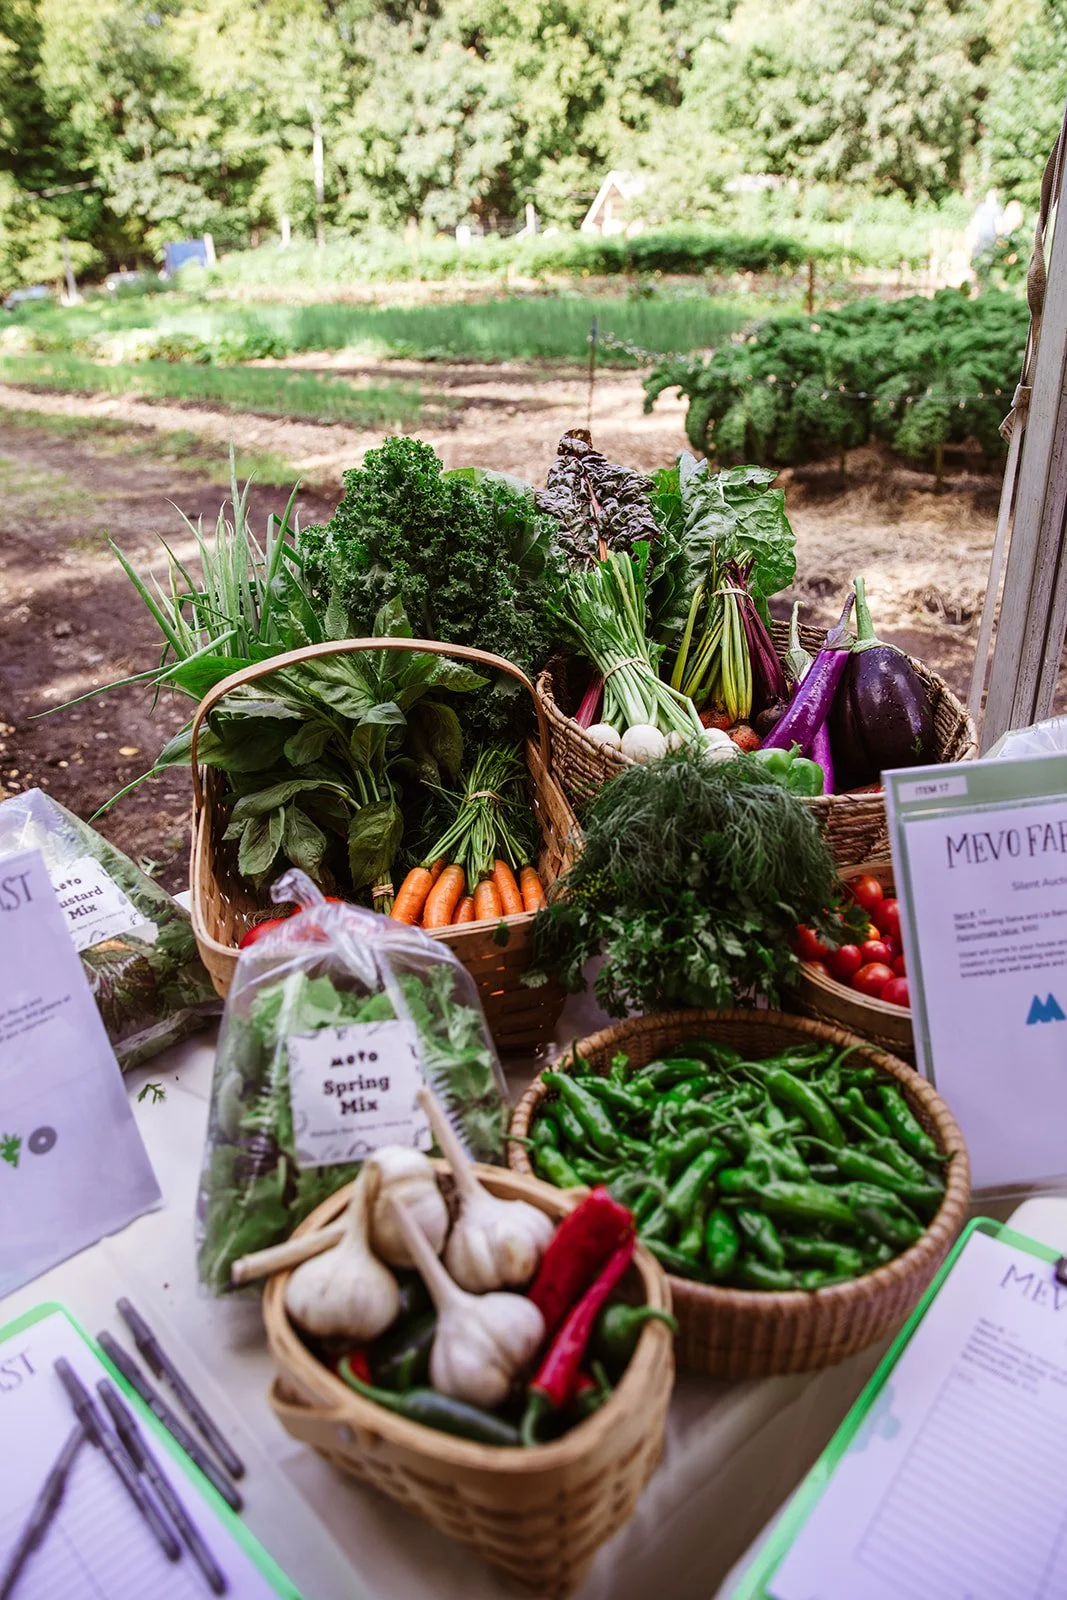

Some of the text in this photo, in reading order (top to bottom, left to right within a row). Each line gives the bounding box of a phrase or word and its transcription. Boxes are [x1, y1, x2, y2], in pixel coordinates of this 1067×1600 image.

[914, 784, 937, 795] ITEM
[946, 829, 1021, 869] MEVO
[60, 885, 103, 908] ustard
[68, 904, 97, 920] Mix
[323, 1075, 390, 1098] Spring
[340, 1097, 378, 1115] Mix
